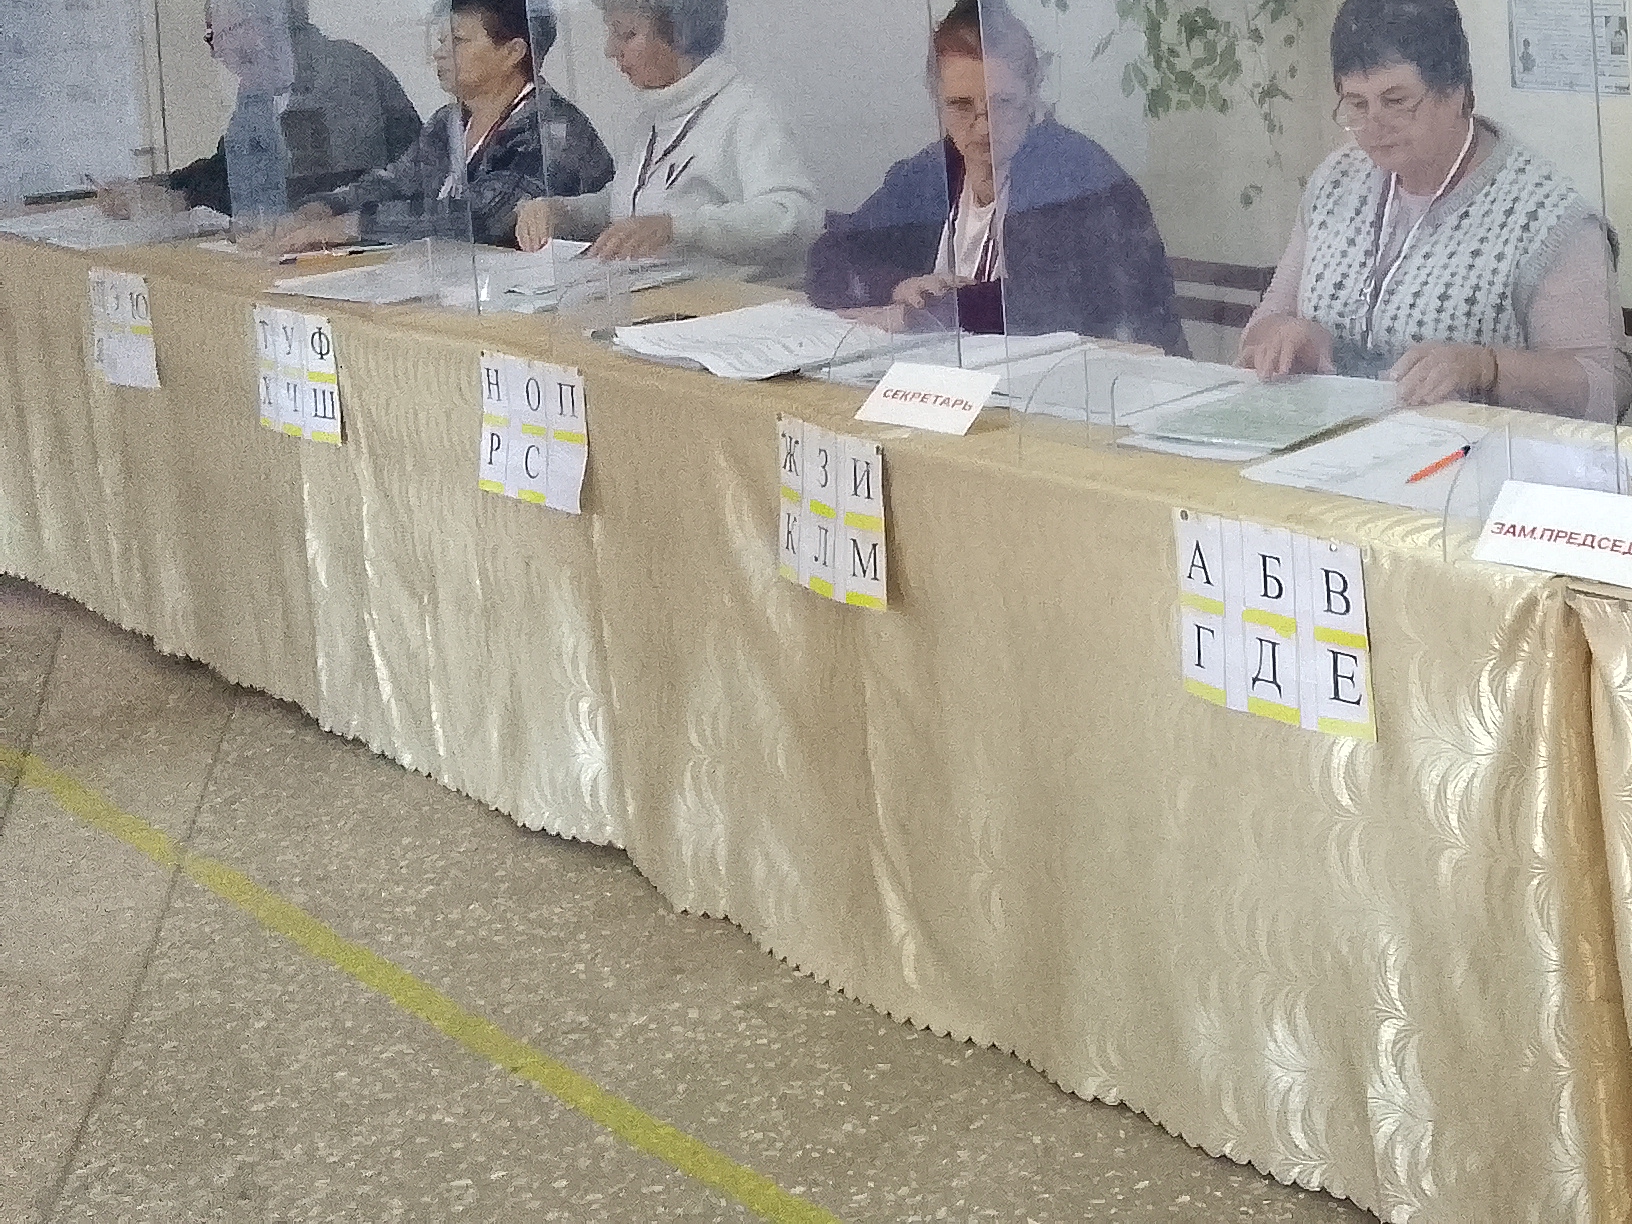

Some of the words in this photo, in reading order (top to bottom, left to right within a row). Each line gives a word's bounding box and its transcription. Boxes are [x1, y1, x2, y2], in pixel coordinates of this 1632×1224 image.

[129, 291, 149, 320] Ю
[310, 326, 330, 361] Ф
[312, 387, 336, 420] Ш
[484, 367, 503, 402] Н
[525, 377, 541, 412] О
[556, 382, 579, 418] П
[882, 387, 973, 412] СЕКРЕТАРЬ
[487, 432, 501, 466] Р
[524, 444, 541, 480] С
[781, 431, 800, 477] Ж
[817, 448, 829, 488] З
[851, 457, 874, 500] И
[785, 513, 798, 555] К
[813, 525, 829, 567] Л
[850, 538, 880, 581] М
[1187, 539, 1214, 587] А
[1258, 552, 1284, 600] Б
[1320, 567, 1352, 616] В
[1193, 624, 1215, 669] Г
[1251, 636, 1283, 698] Д
[1327, 648, 1363, 707] Е
